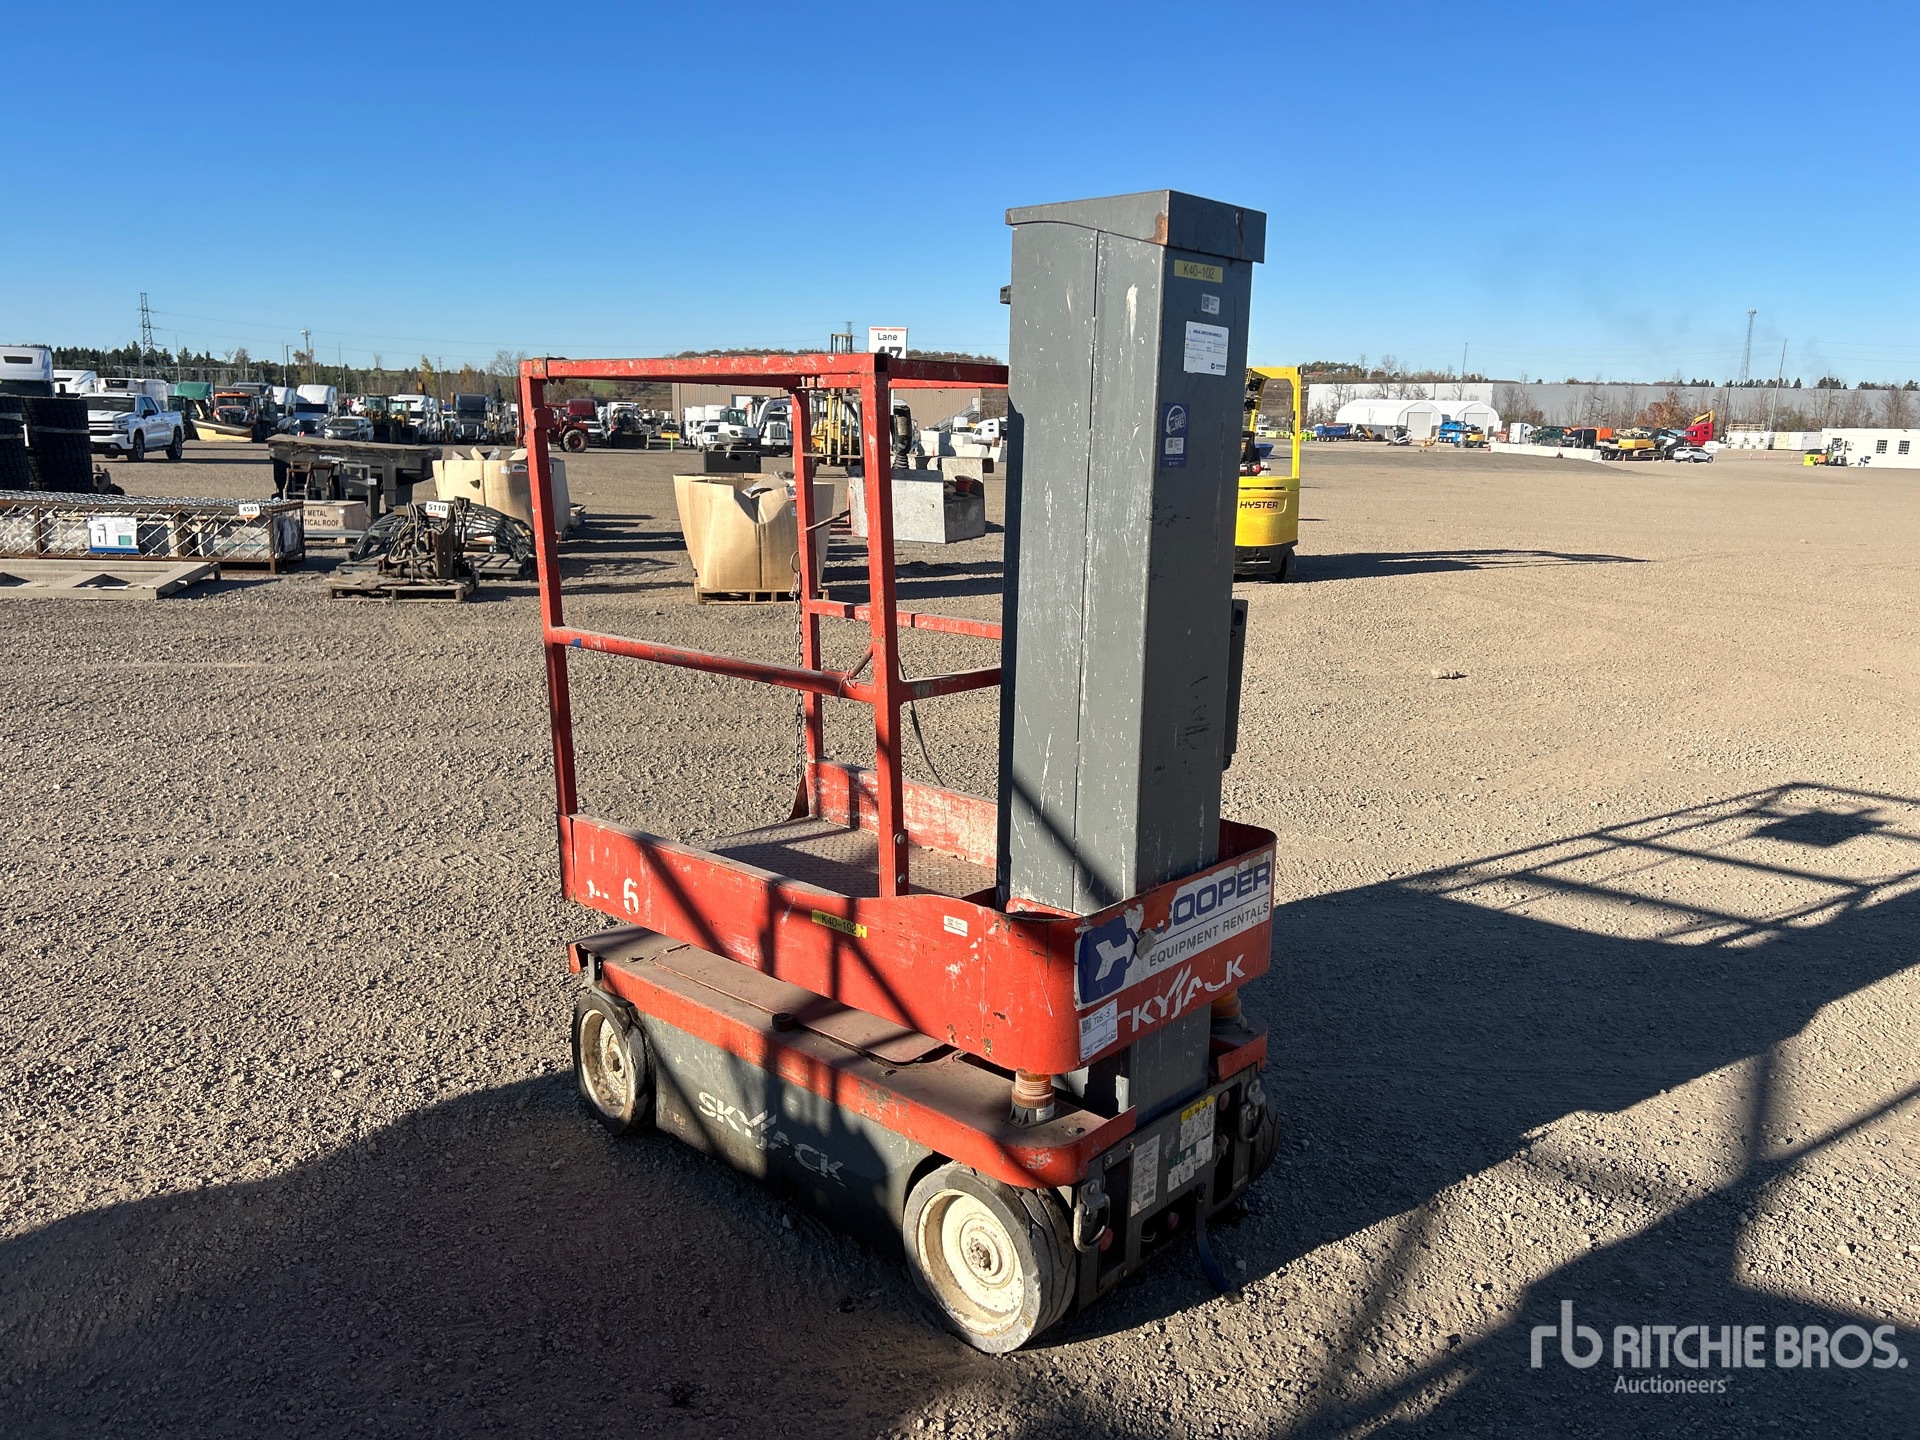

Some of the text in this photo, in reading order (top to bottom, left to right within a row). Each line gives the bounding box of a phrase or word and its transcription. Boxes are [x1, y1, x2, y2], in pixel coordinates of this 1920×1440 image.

[1183, 263, 1215, 280] K40-102
[877, 332, 898, 341] Lane
[428, 504, 447, 512] 5110
[1239, 501, 1279, 509] HYSTER
[307, 509, 328, 517] METAL
[304, 518, 340, 527] TICAL ROOF
[1155, 860, 1271, 936] OOPER
[820, 913, 857, 935] K40-102
[1150, 901, 1270, 967] EQUIPMENT RENTALS
[1118, 953, 1246, 1032] KYJAK
